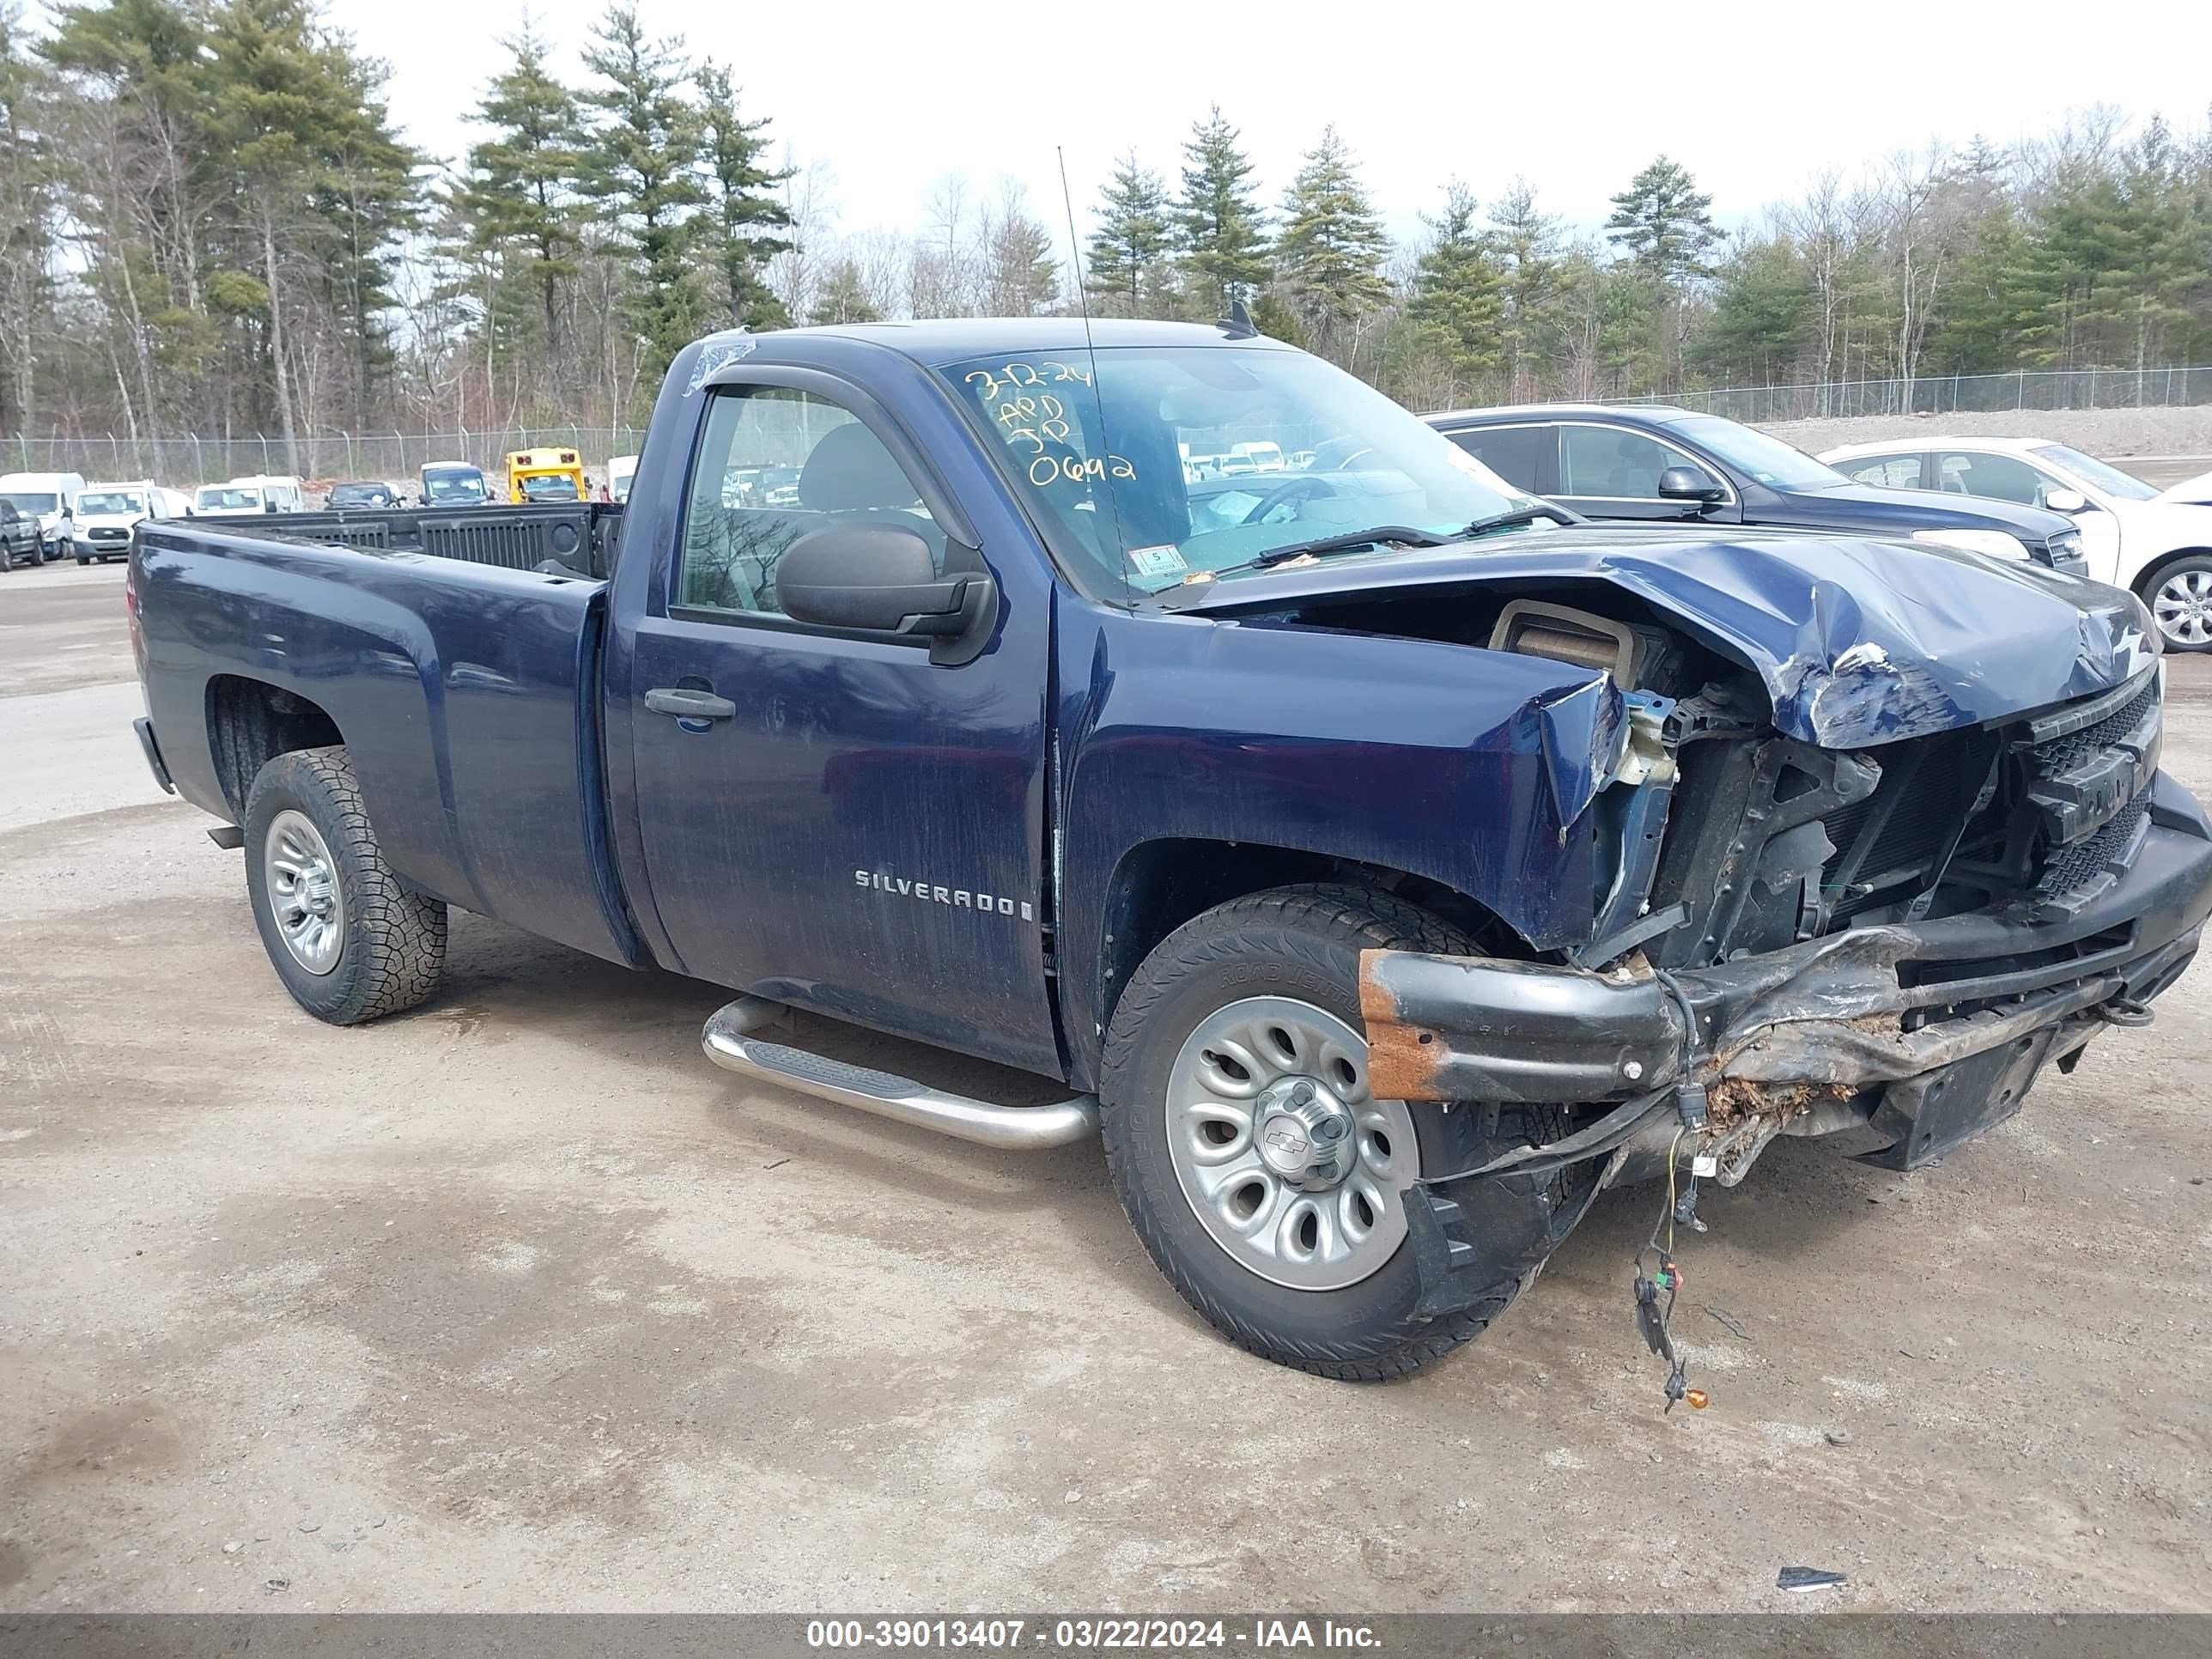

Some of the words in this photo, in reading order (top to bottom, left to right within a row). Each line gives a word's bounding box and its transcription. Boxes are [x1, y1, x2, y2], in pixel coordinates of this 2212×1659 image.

[965, 362, 1091, 400] 3-12-24
[999, 394, 1064, 428] APD
[1029, 455, 1137, 487] 0692
[1152, 552, 1161, 562] 5
[854, 870, 1015, 916] SILVERADO
[1219, 962, 1282, 989] ROAD
[1287, 963, 1362, 1016] VENTU
